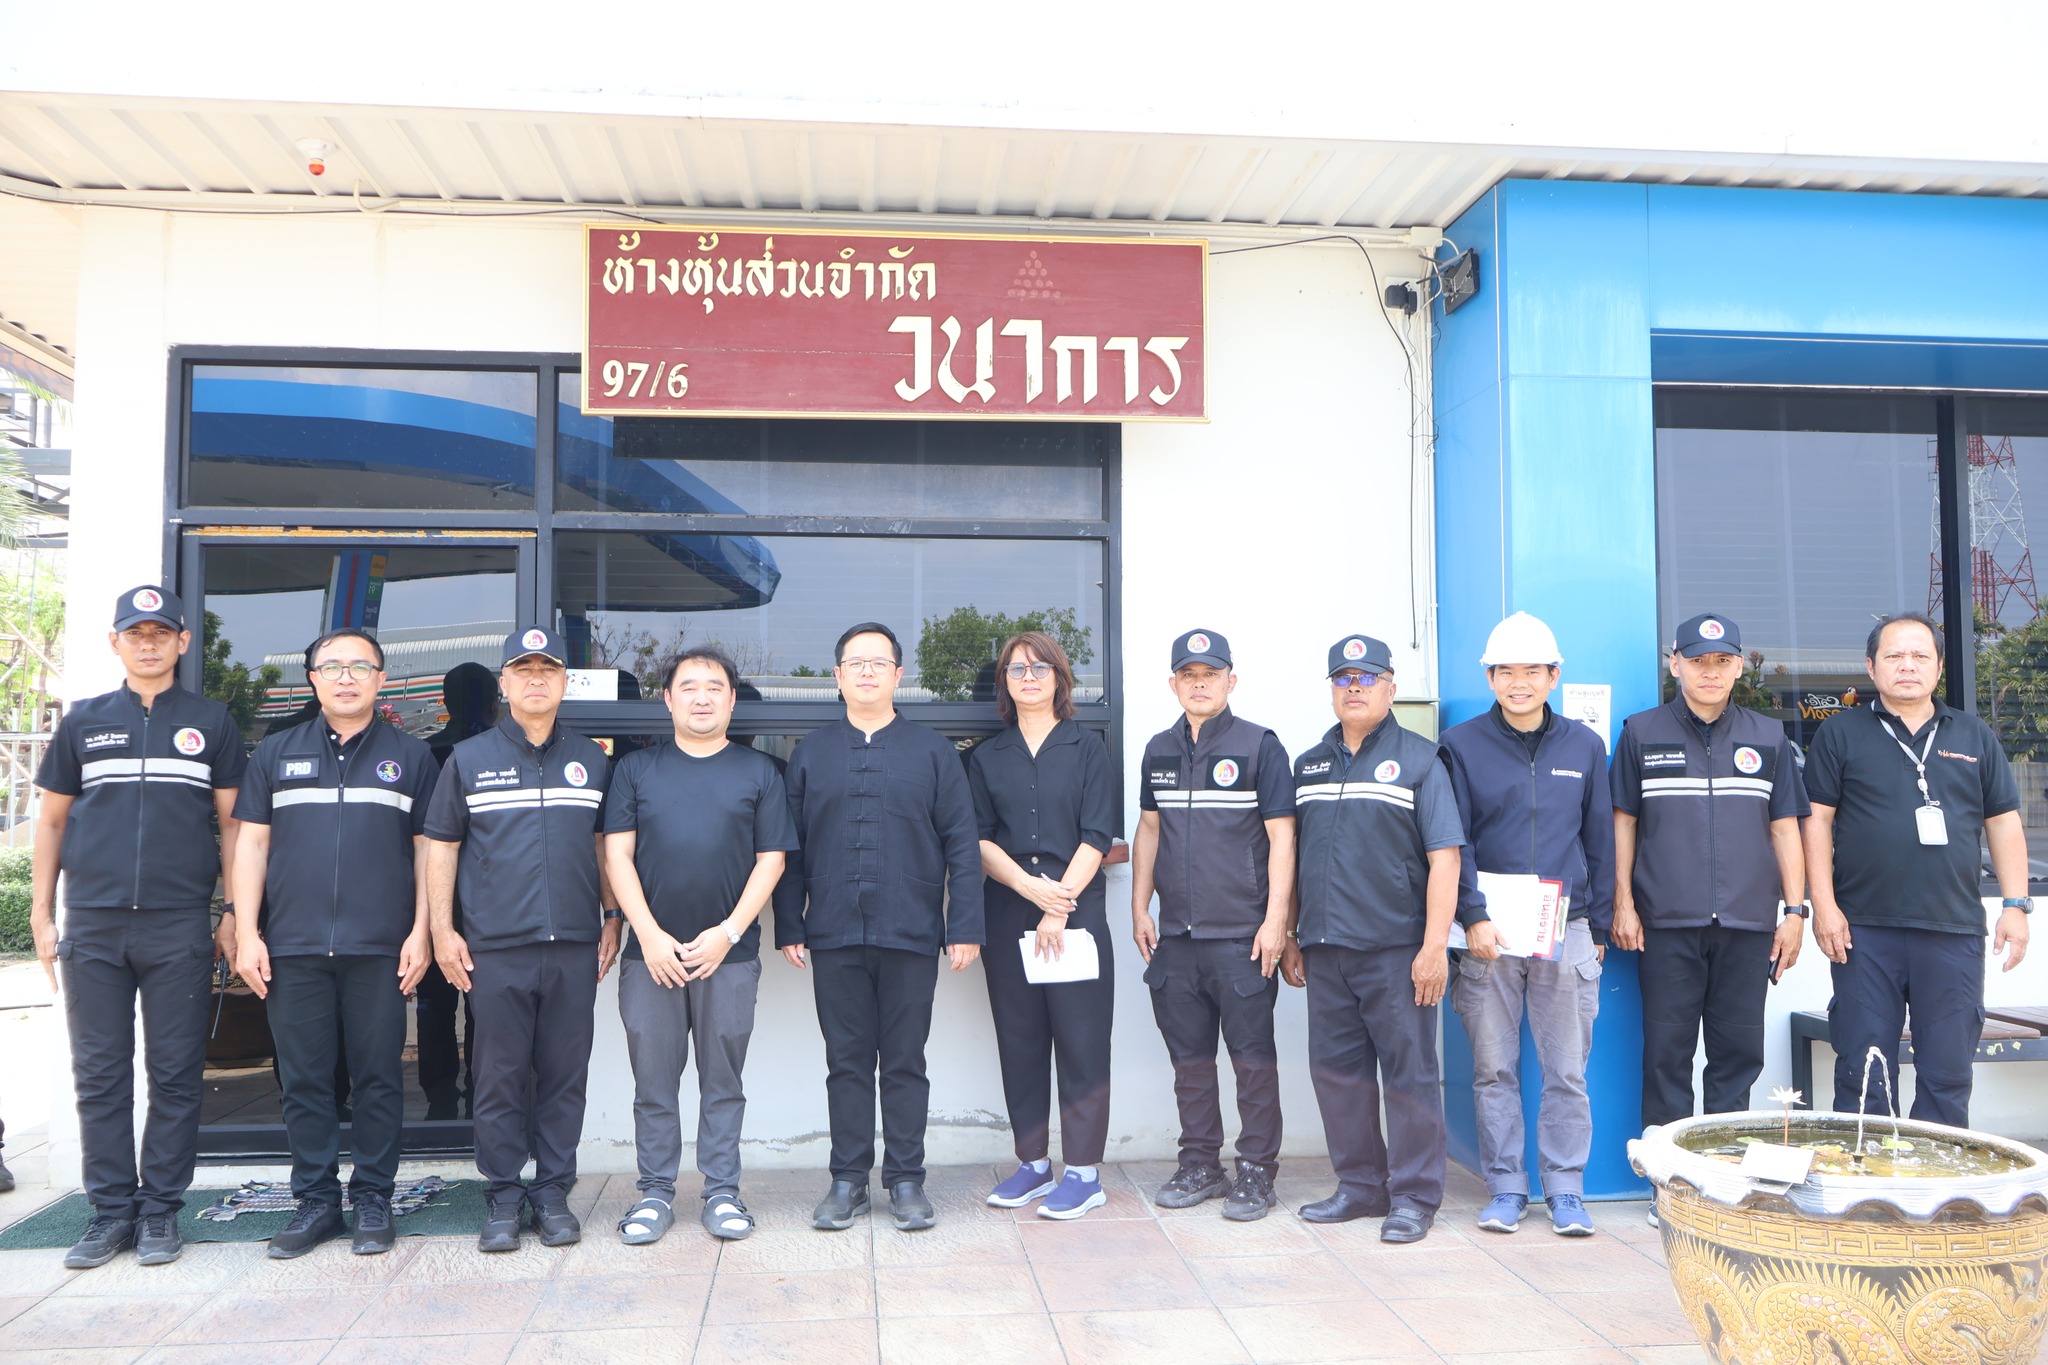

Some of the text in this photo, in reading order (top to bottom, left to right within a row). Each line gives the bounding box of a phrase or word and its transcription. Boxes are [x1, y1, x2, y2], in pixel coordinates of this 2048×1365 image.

[602, 232, 937, 314] ห้างหุ้นส่วนจำกัด
[602, 359, 689, 399] 97/6
[888, 315, 1190, 406] วนาการ
[285, 761, 312, 776] PRD
